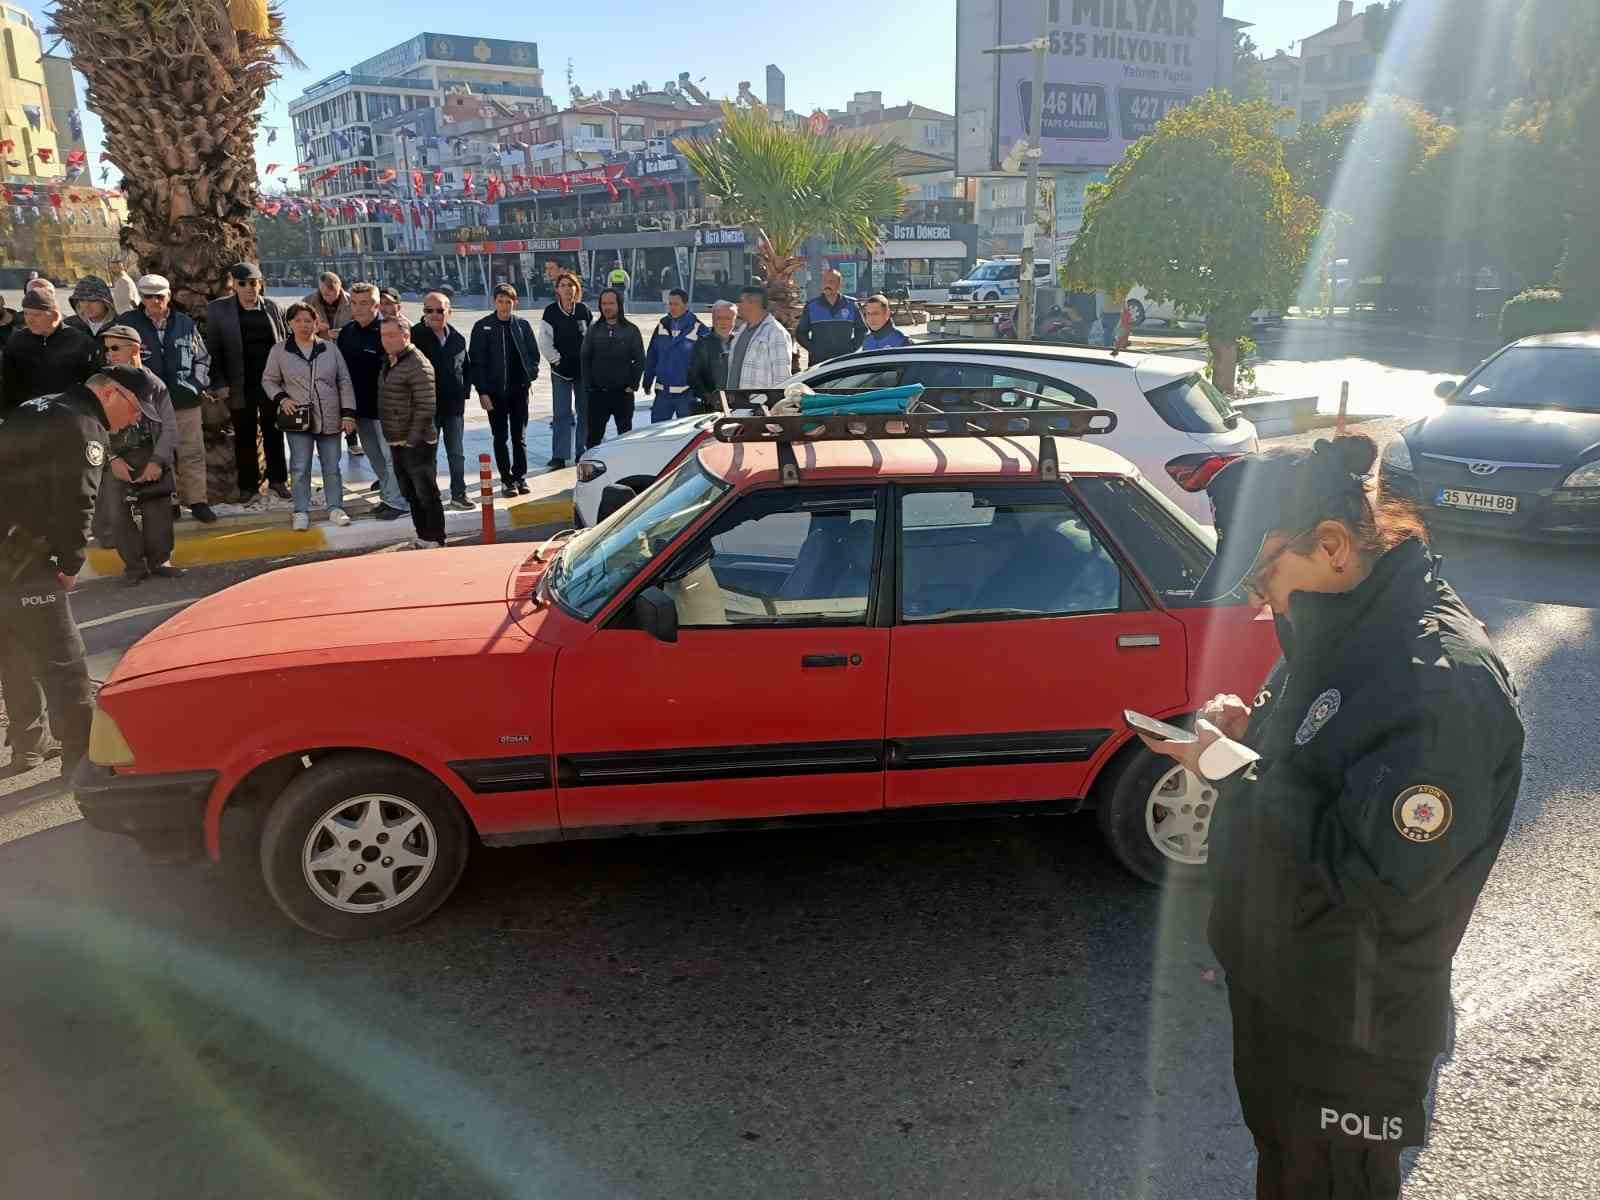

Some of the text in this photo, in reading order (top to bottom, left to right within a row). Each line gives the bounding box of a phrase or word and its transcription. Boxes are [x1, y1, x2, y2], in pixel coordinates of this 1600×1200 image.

[1048, 30, 1087, 56] 635
[1173, 42, 1192, 65] TL
[1071, 92, 1097, 116] KM
[1131, 95, 1159, 118] 427
[1443, 490, 1514, 510] 35 YHH 88
